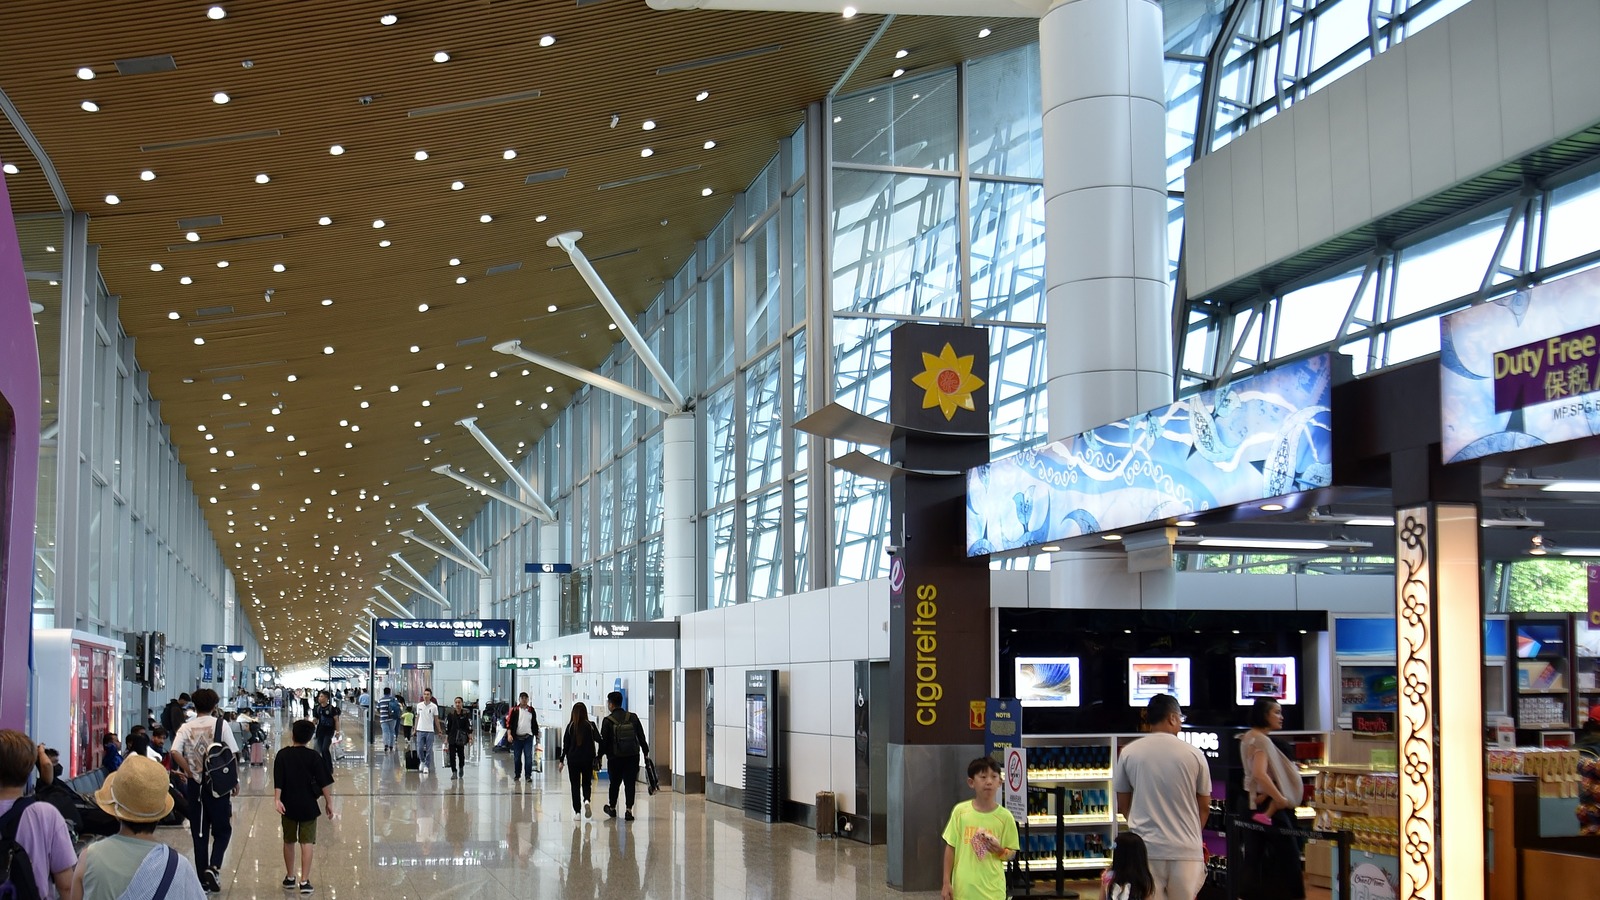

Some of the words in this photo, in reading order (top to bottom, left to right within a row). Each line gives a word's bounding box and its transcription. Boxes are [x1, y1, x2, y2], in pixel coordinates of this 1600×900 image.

[1494, 349, 1544, 379] Duty
[1547, 334, 1596, 366] Free
[913, 584, 943, 726] cigarettes
[1356, 717, 1388, 734] Beryl's
